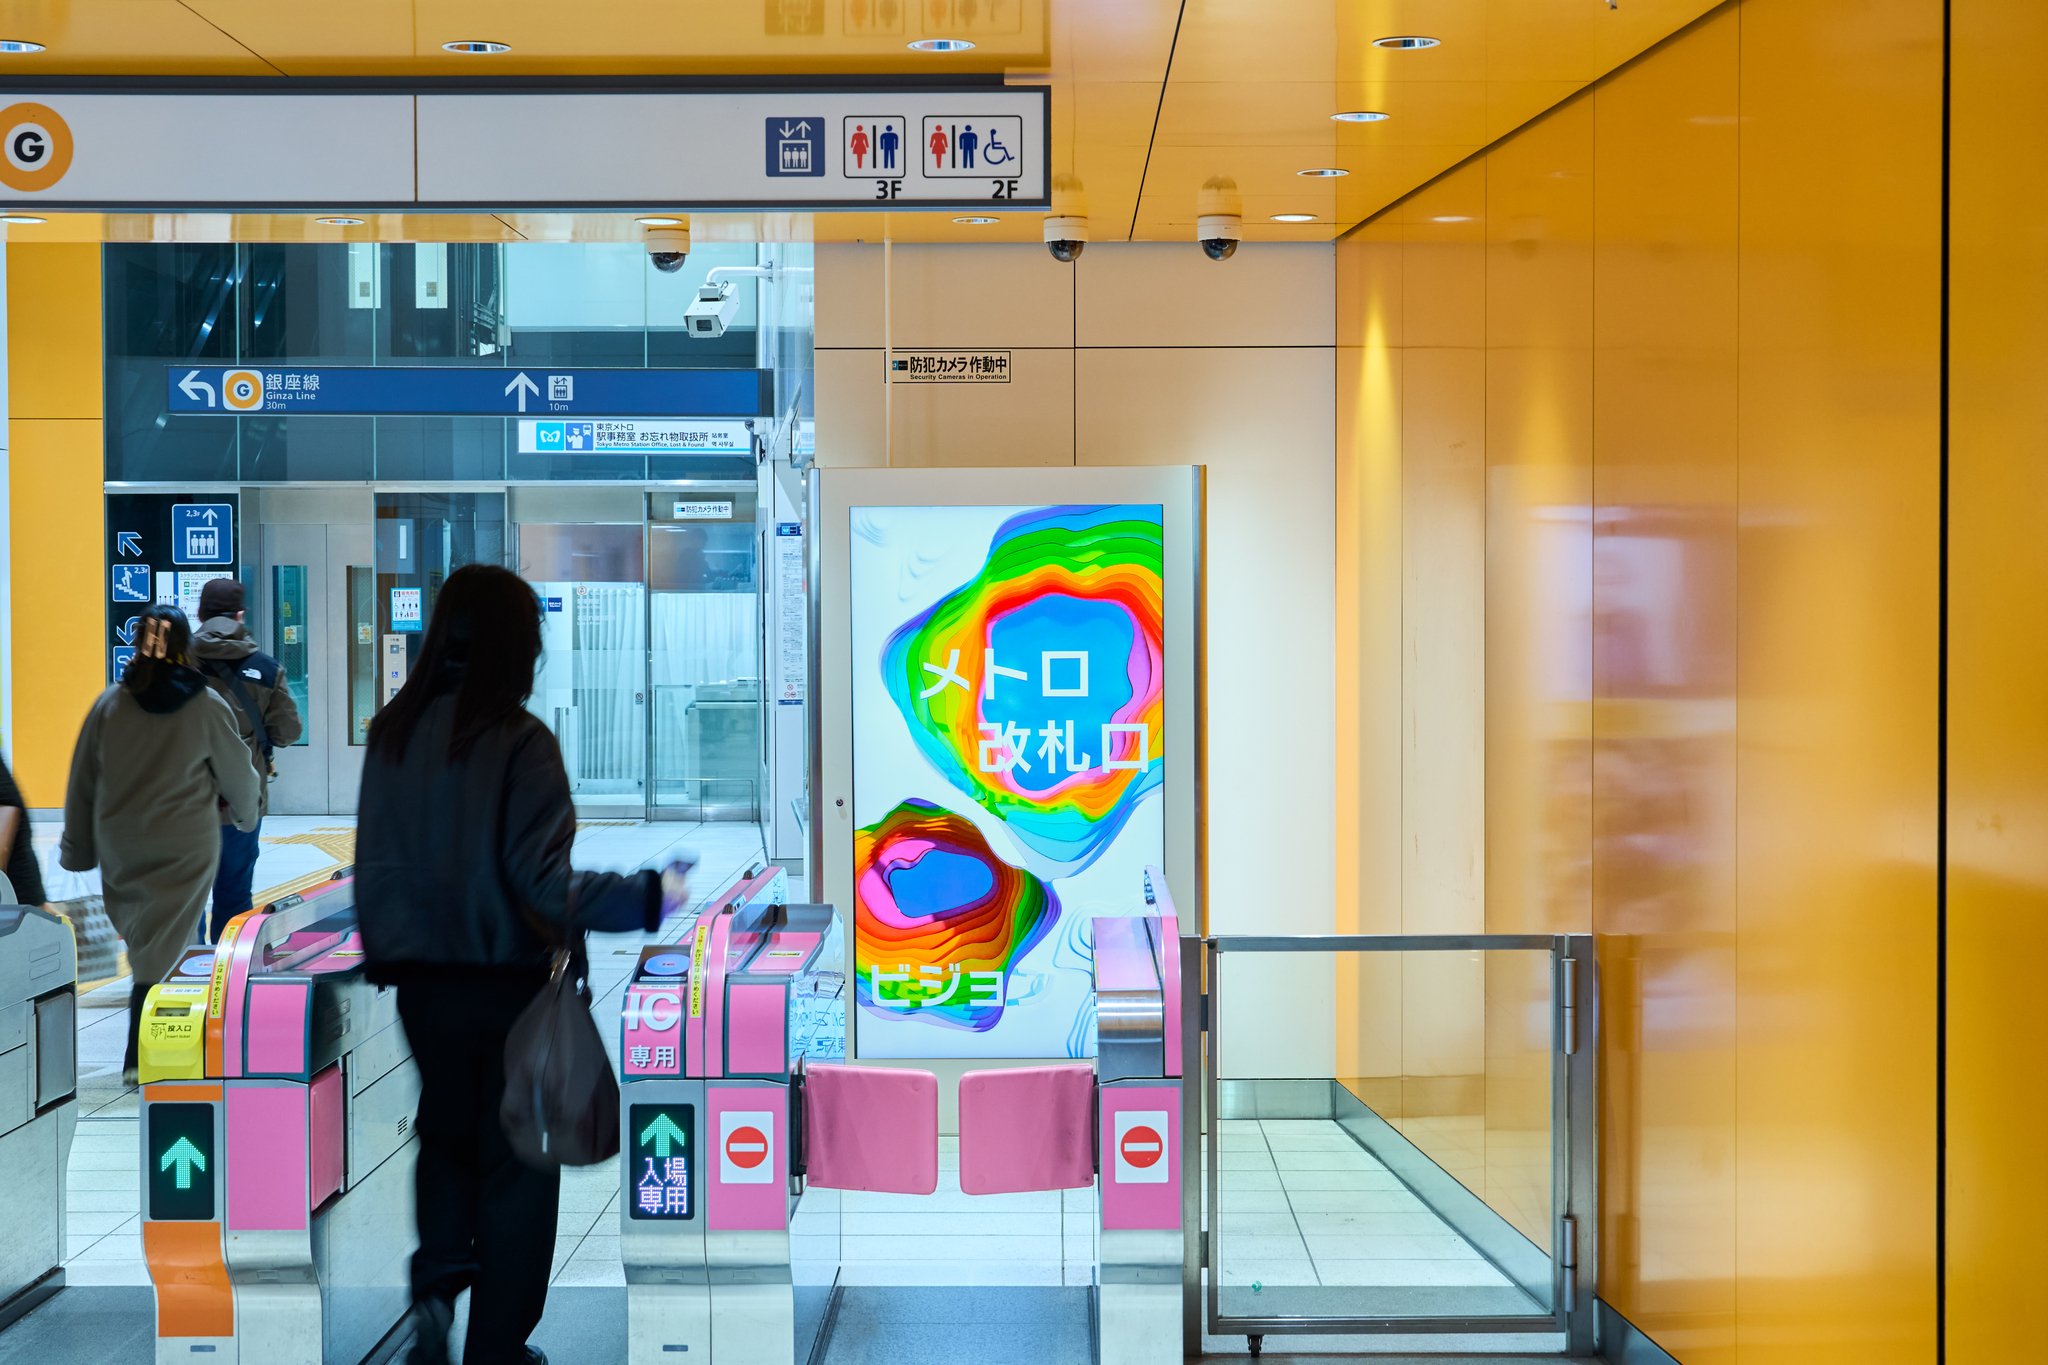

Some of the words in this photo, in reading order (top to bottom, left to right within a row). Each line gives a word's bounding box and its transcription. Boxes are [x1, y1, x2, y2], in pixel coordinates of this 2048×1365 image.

[14, 131, 45, 163] G
[876, 180, 902, 200] 3F
[992, 180, 1019, 200] 2F
[237, 384, 250, 397] G
[266, 374, 320, 391] 銀座線
[266, 392, 293, 400] Ginza
[296, 392, 316, 400] Line
[266, 402, 286, 410] 30m
[549, 403, 569, 411] 10m
[597, 423, 634, 431] 東京メトロ
[597, 432, 636, 442] 駅事務室
[640, 432, 709, 442] お忘れ物取扱所
[920, 649, 1089, 700] メトロ
[978, 720, 1149, 774] 改札口
[871, 963, 1004, 1007] ビジョ
[627, 992, 681, 1032] IC
[167, 1024, 192, 1032] 投入口
[629, 1045, 676, 1068] 専用
[639, 1157, 687, 1186] 入場
[639, 1185, 687, 1214] 専用
